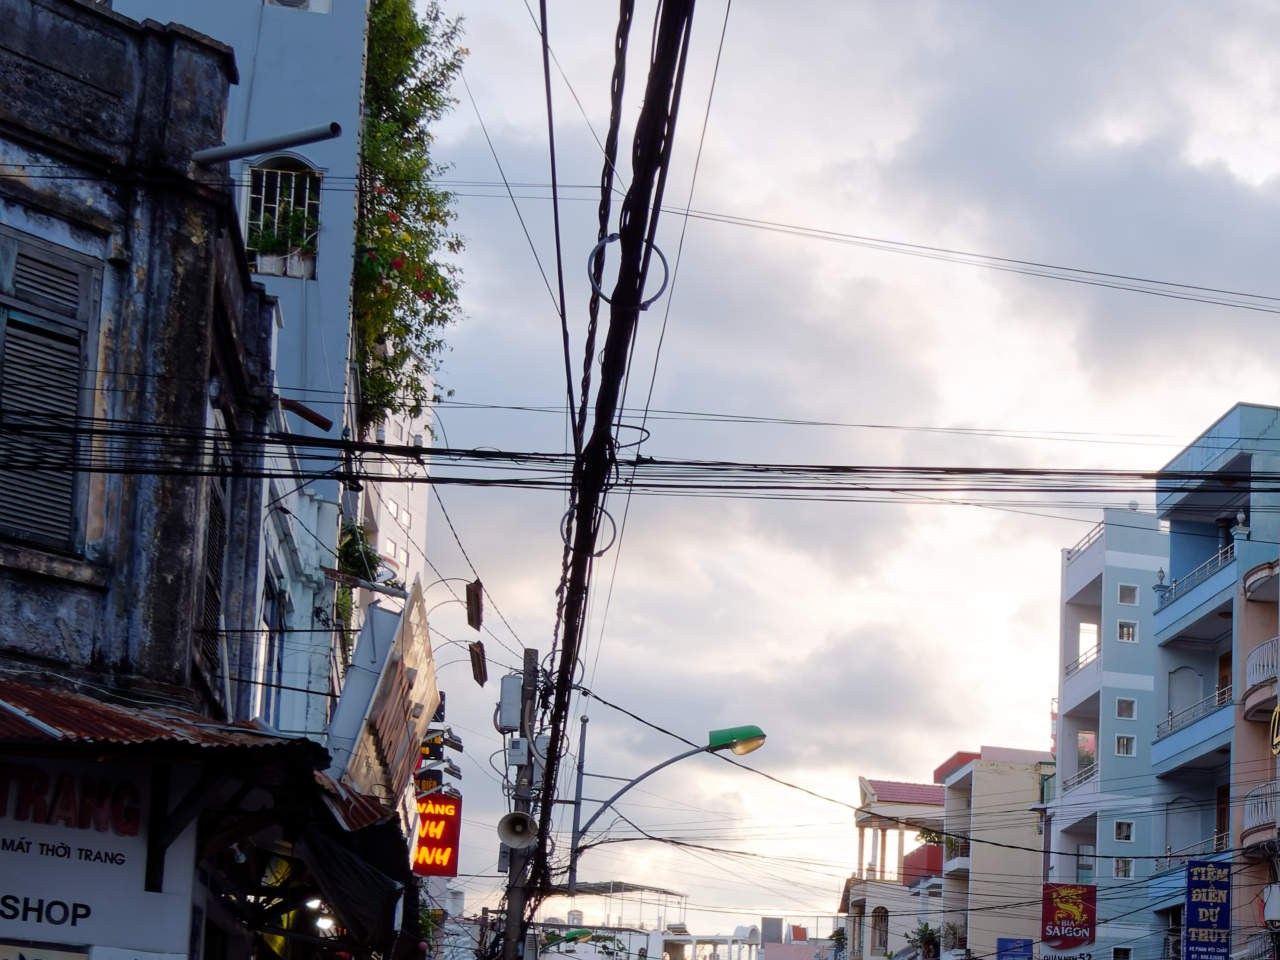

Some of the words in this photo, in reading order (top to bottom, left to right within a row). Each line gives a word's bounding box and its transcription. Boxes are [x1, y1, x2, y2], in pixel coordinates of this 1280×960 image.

[77, 847, 126, 865] TRANG
[0, 894, 91, 928] SHOP
[1045, 925, 1090, 937] SAIGON
